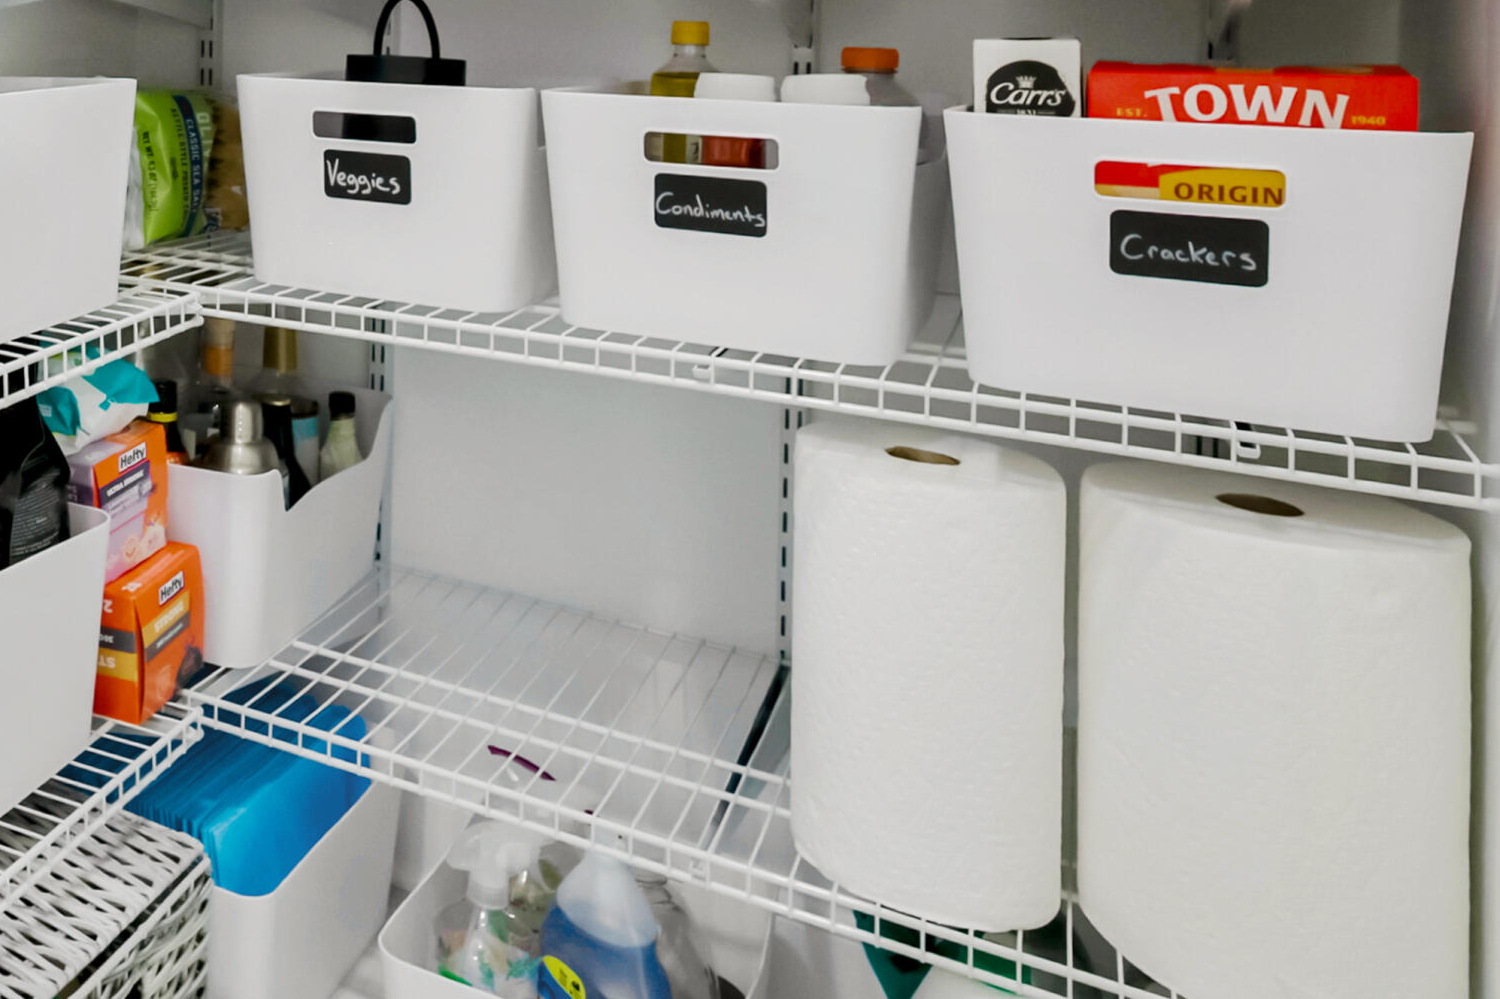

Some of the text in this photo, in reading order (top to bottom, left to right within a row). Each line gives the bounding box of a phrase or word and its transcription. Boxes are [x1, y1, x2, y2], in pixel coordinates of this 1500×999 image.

[1116, 107, 1387, 126] EST. 1940
[1144, 83, 1350, 129] TOWN
[185, 118, 201, 161] CLASSIC
[325, 158, 401, 195] Veggies
[1174, 181, 1283, 205] ORIGIN
[655, 191, 766, 228] Condiments
[1119, 232, 1257, 271] Crackers
[120, 447, 145, 469] Hefty
[160, 578, 182, 601] Hefty
